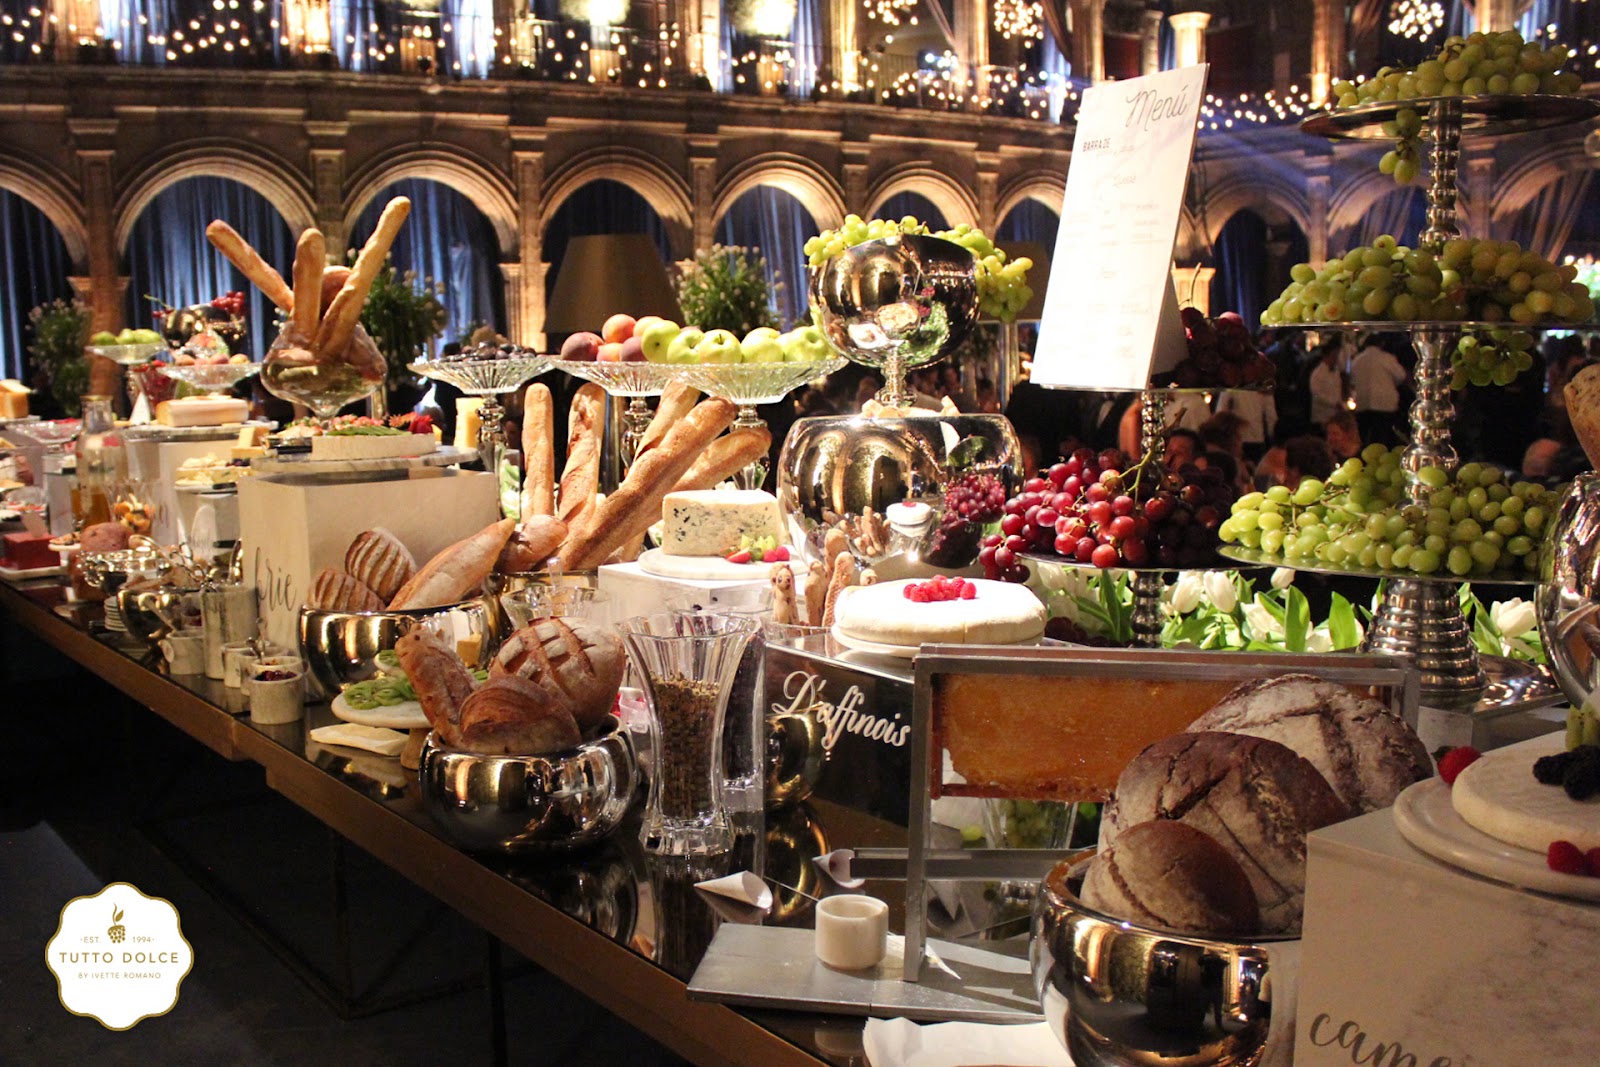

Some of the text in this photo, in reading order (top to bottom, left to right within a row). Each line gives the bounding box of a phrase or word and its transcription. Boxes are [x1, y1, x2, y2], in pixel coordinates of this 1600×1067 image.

[1125, 85, 1189, 132] Menú
[1083, 139, 1102, 152] BARRA
[1103, 137, 1111, 149] DE
